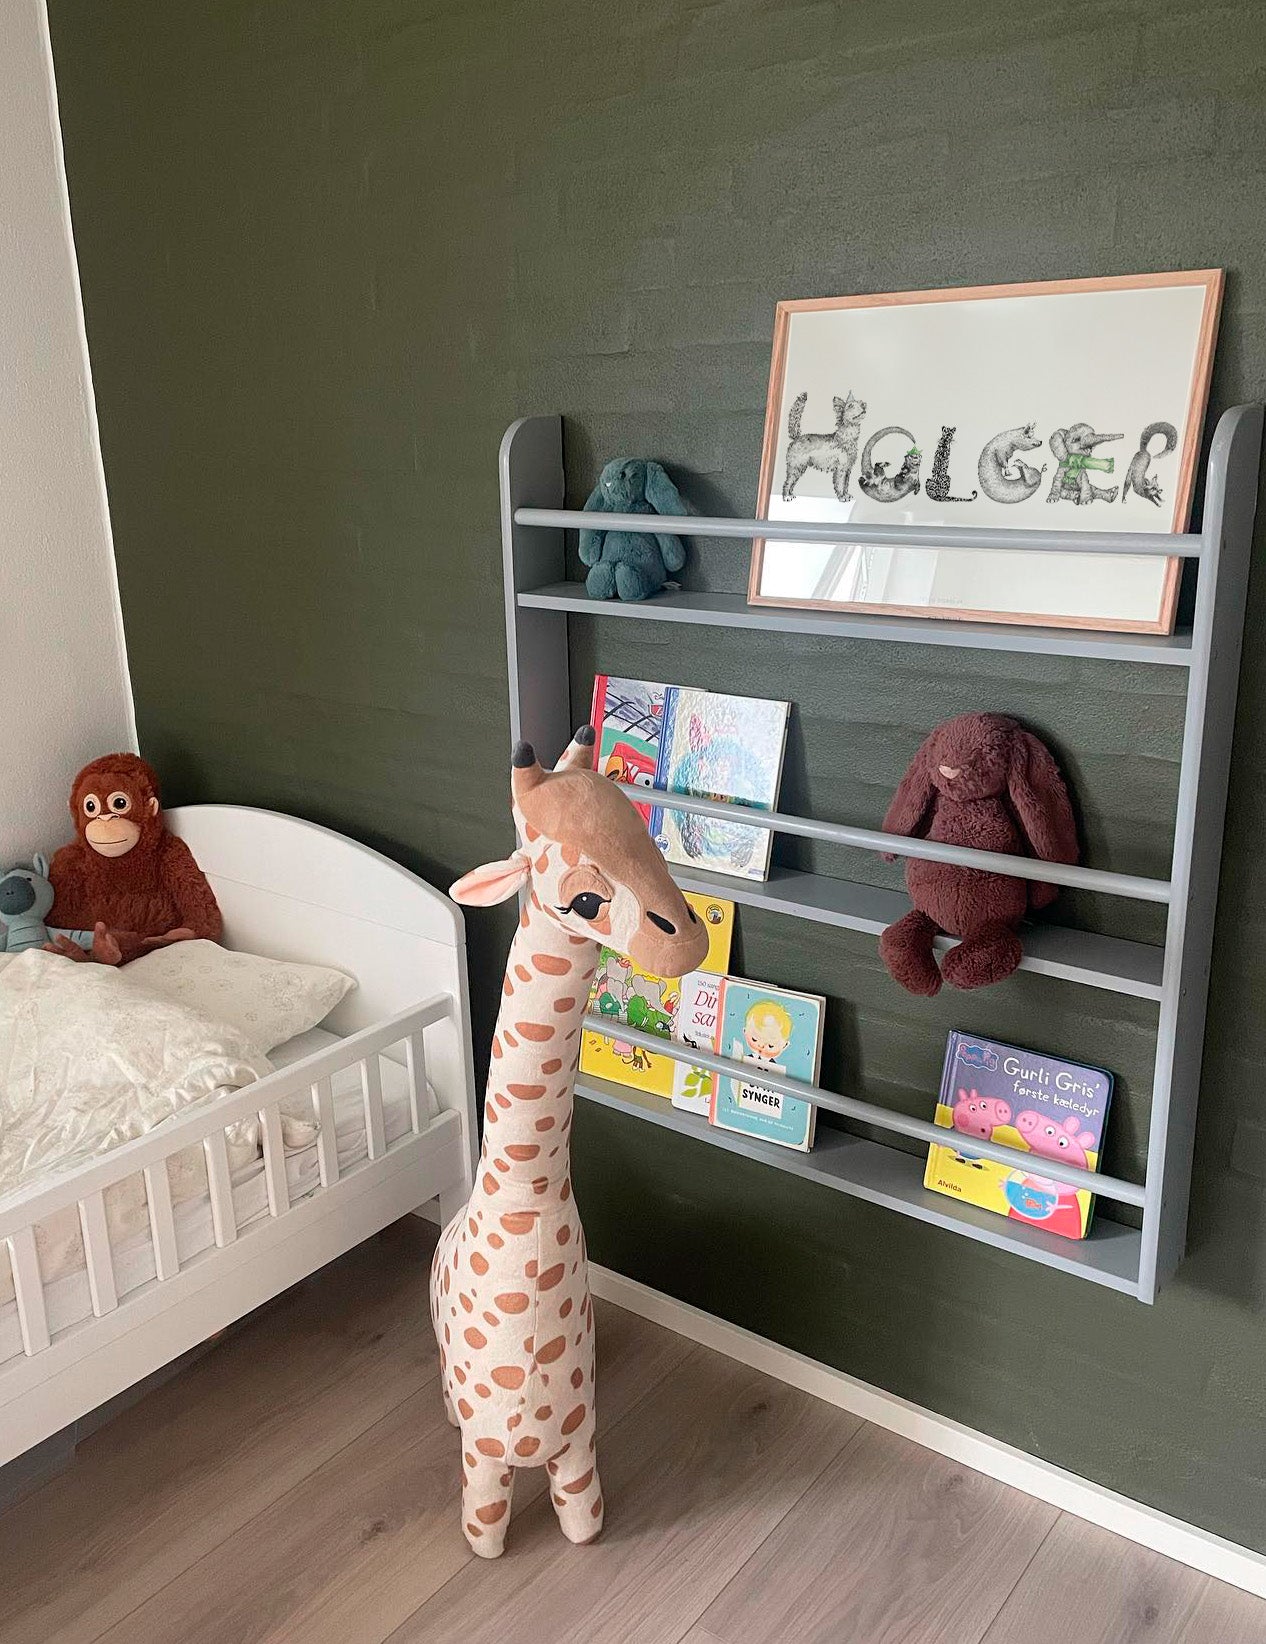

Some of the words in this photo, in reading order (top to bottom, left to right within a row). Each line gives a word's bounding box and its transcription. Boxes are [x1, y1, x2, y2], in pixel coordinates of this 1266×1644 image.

[1003, 1057, 1050, 1086] Gurli
[742, 1088, 780, 1109] SYNGER
[1013, 1080, 1050, 1103] første
[1053, 1093, 1100, 1118] kæledyr
[937, 1179, 962, 1193] Alvilda
